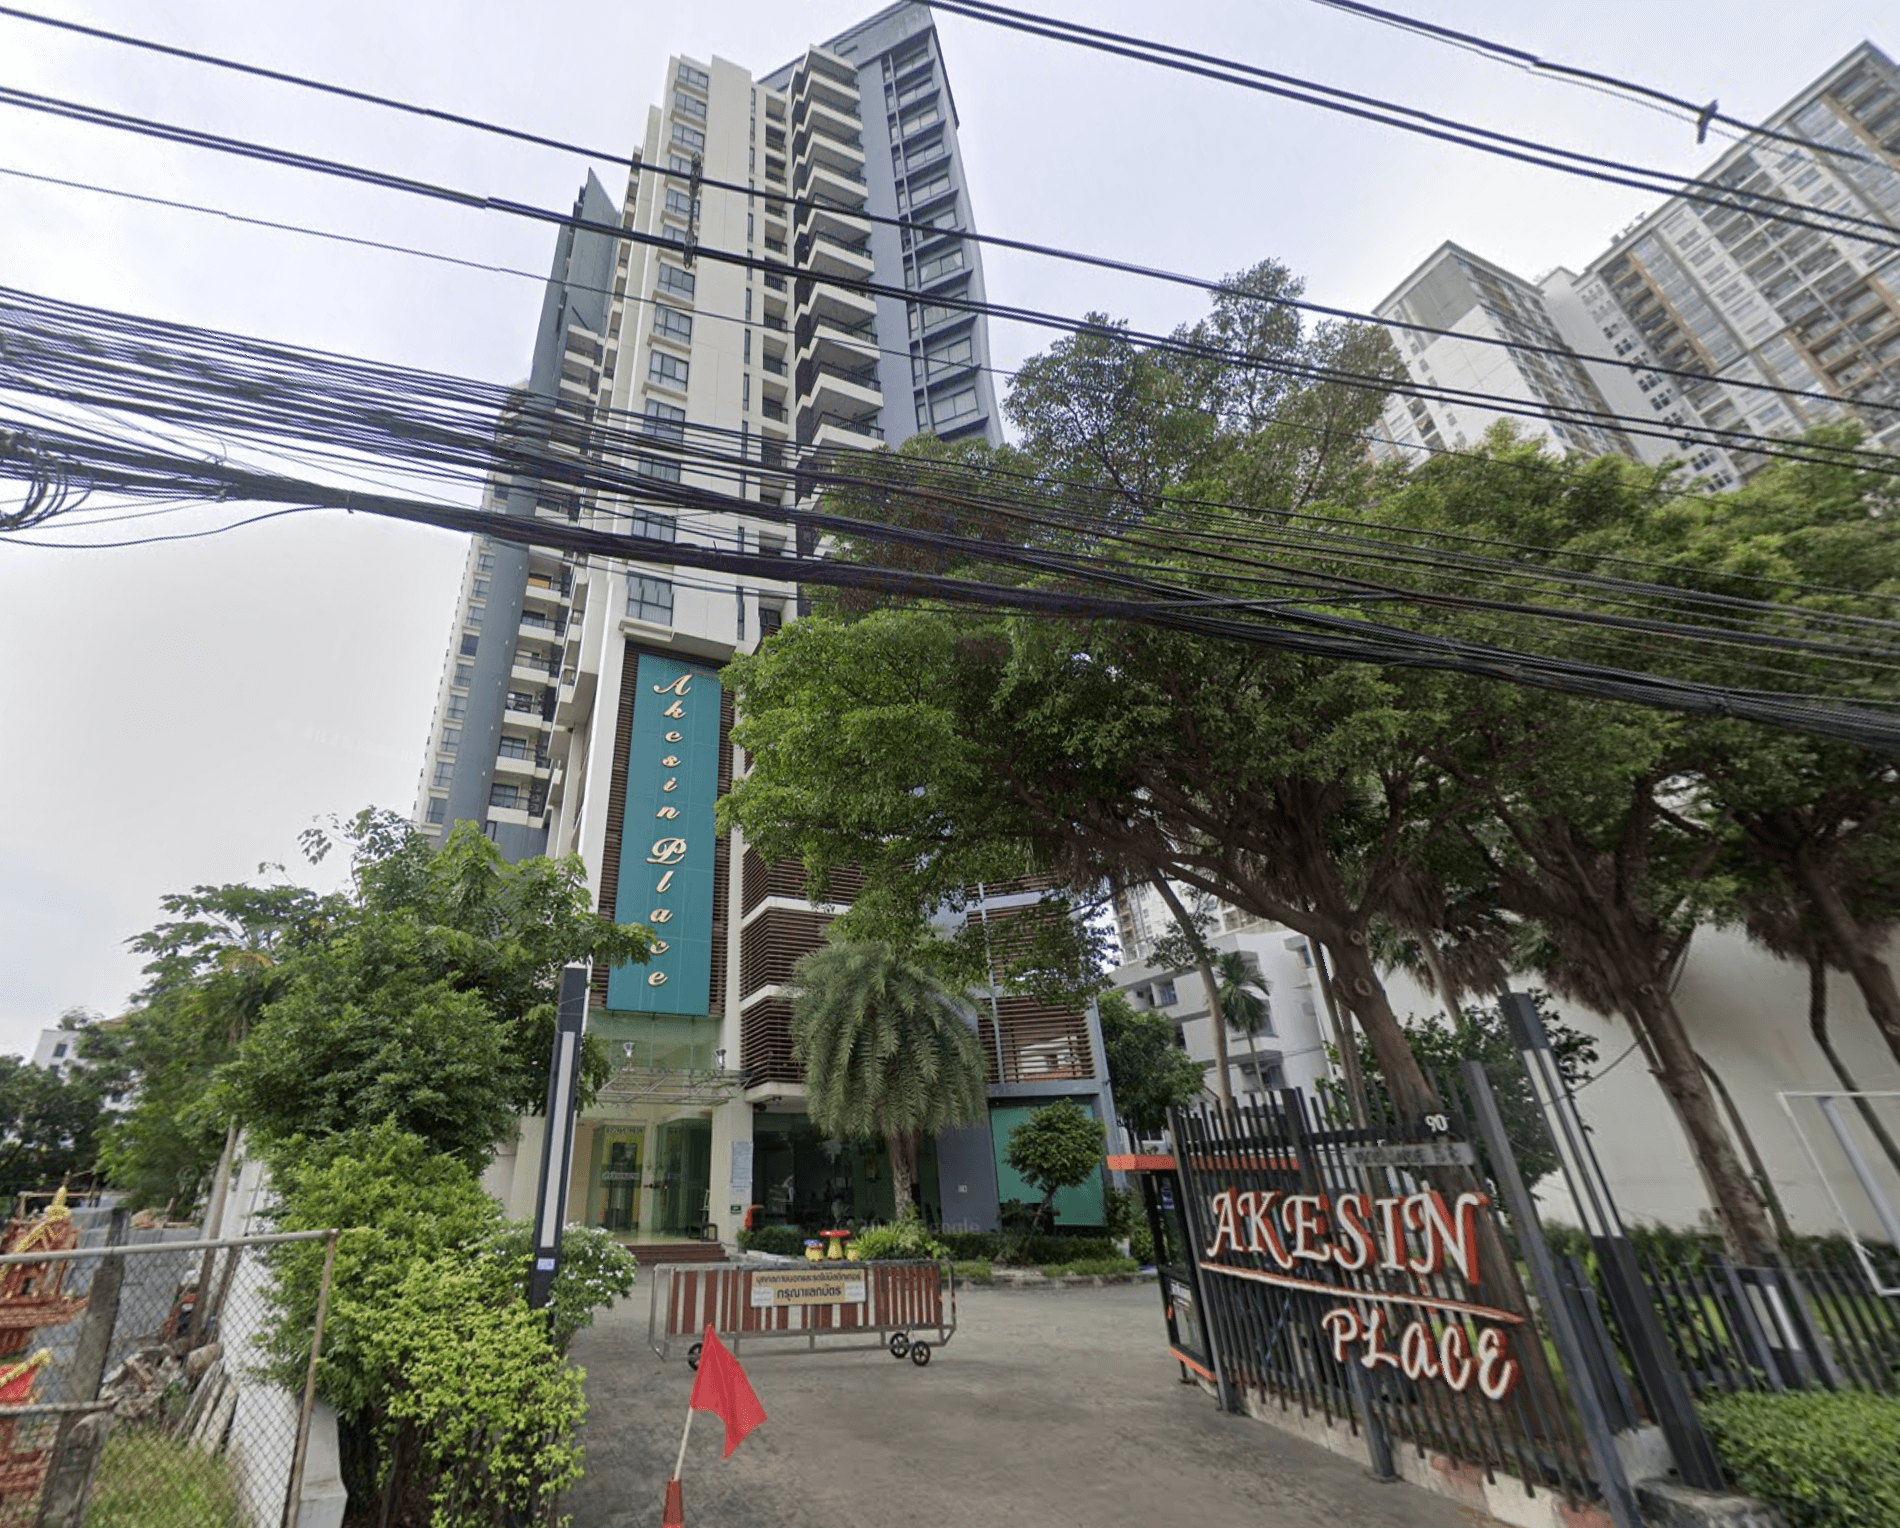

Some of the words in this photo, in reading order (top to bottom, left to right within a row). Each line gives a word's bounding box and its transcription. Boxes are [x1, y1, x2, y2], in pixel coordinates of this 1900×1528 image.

[653, 673, 693, 821] Akesin
[646, 836, 687, 988] Place
[1424, 1113, 1449, 1132] 90
[1206, 1186, 1490, 1286] AKESIN
